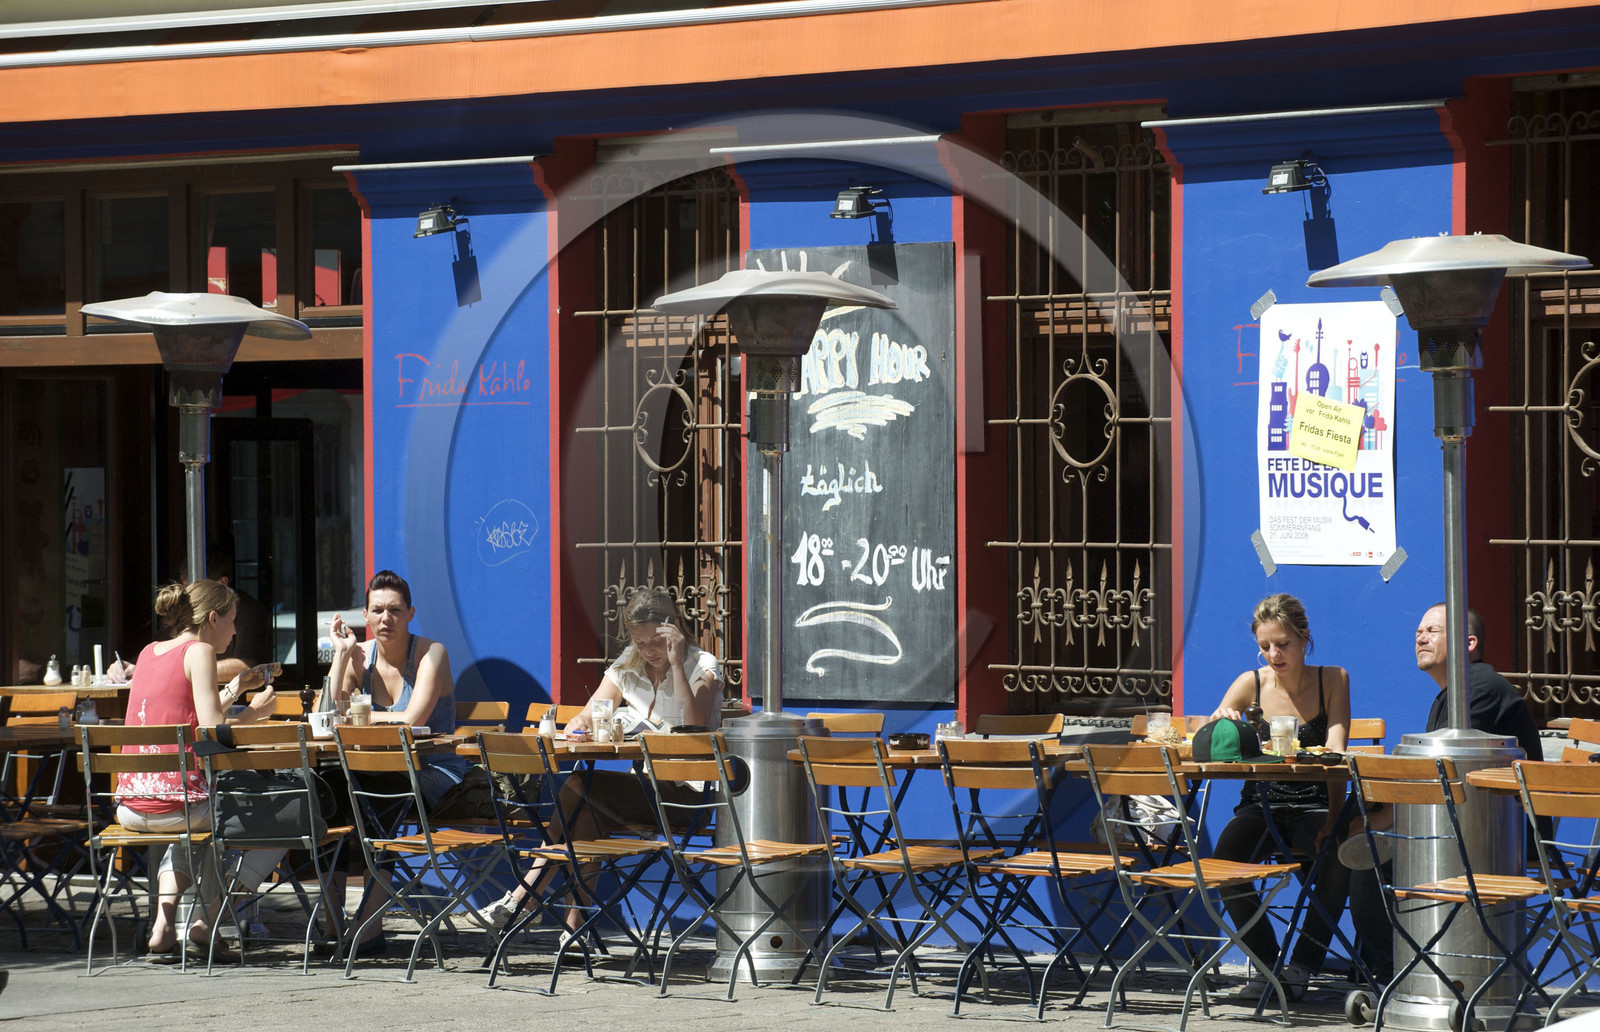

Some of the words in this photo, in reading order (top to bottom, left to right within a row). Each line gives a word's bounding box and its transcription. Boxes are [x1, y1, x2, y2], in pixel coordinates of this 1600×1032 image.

[868, 332, 931, 386] HOUR
[394, 353, 467, 402] Frida
[479, 359, 530, 396] Kahlo
[1319, 410, 1333, 420] Frida
[1334, 415, 1351, 425] Kahlo
[1300, 421, 1324, 437] Fridas
[1326, 429, 1352, 445] Fiesta
[1268, 458, 1299, 471] FETE
[1268, 472, 1384, 498] MUSIQUE
[1269, 516, 1281, 524] DAS
[1283, 516, 1298, 524] FEST
[1299, 516, 1311, 524] DER
[1312, 516, 1333, 524] MUSIK
[1280, 532, 1293, 540] JUNI
[911, 546, 950, 592] Uhr
